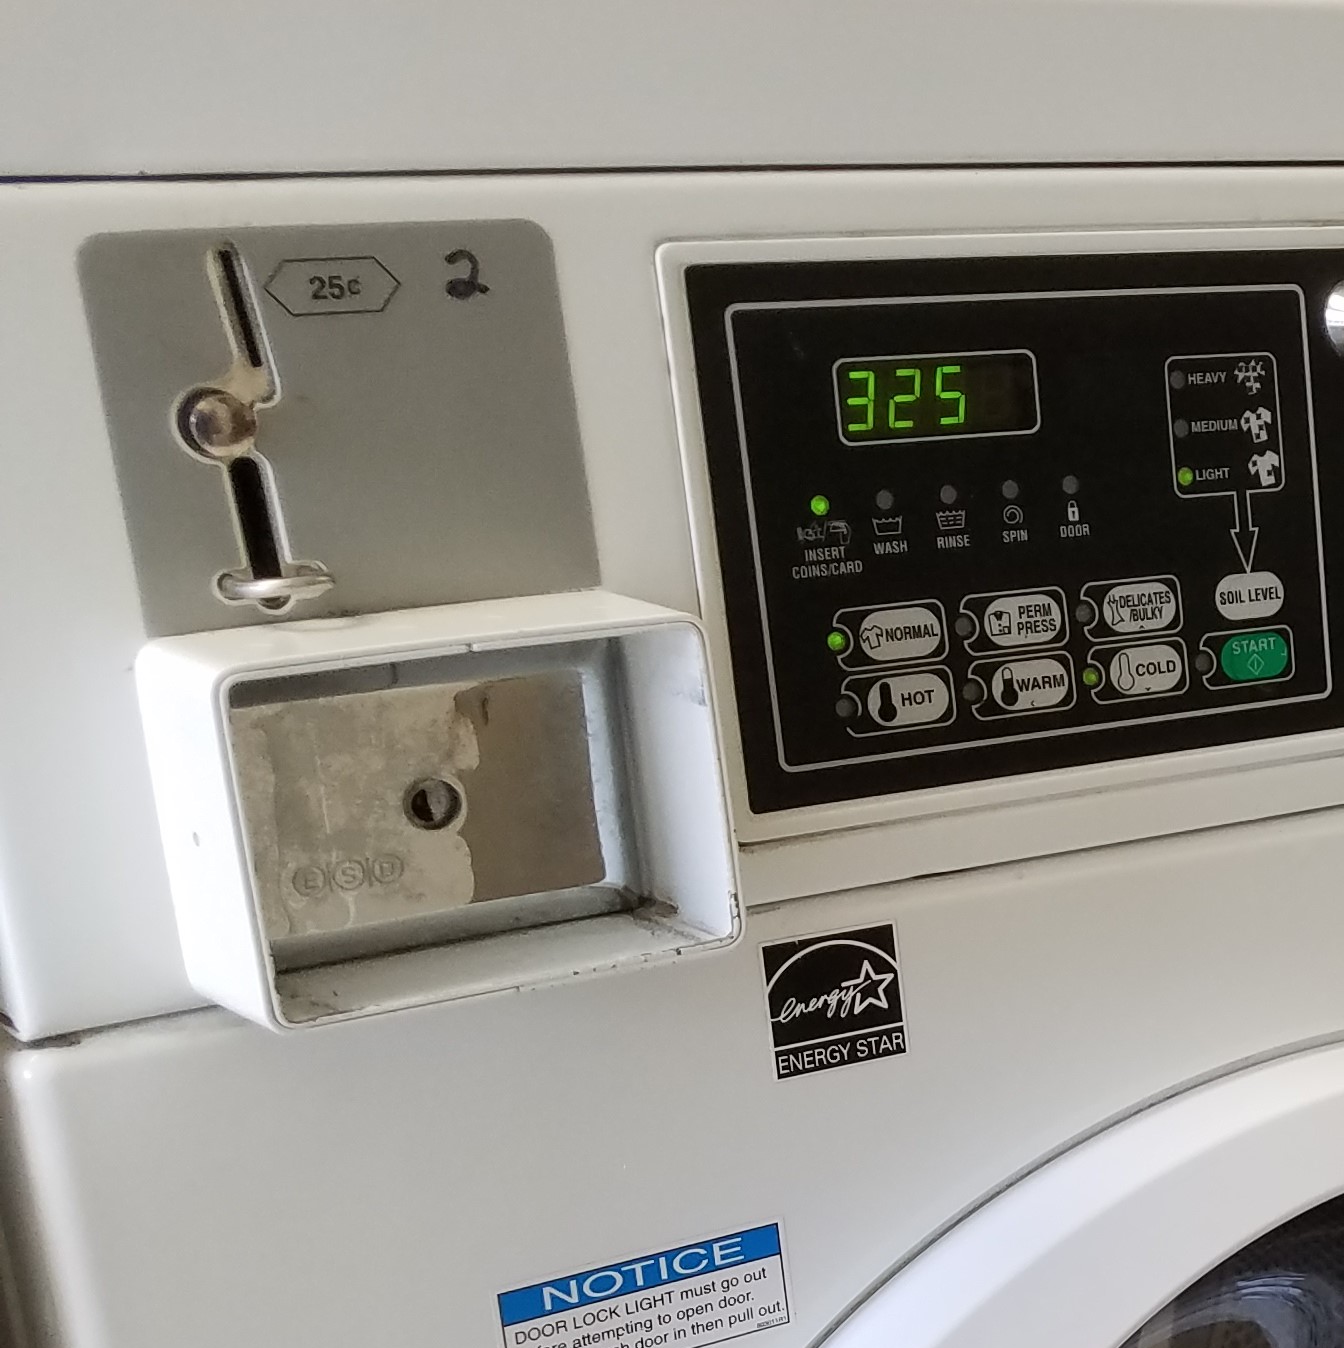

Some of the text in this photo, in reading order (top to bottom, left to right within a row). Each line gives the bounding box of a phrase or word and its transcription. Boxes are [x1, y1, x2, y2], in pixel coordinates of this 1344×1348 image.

[445, 249, 490, 300] 2
[310, 276, 361, 300] 25¢
[1188, 372, 1226, 384] HEAVY
[847, 366, 966, 432] 325
[1191, 419, 1238, 432] MEDIUM
[1196, 468, 1230, 480] LIGHT
[1002, 530, 1028, 542] SPIN
[1060, 524, 1090, 538] DOOR
[874, 540, 908, 554] WASH
[937, 535, 970, 549] RINSE
[804, 546, 846, 562] INSERT
[792, 560, 862, 579] COINS/CARD
[1120, 591, 1171, 608] DELICATES
[1220, 587, 1281, 605] SOIL LEVEL
[1018, 603, 1051, 619] PERM
[1130, 606, 1163, 622] /BULKY
[885, 623, 938, 643] NORMAL
[1017, 619, 1056, 635] PRESS
[1232, 637, 1276, 655] START
[1136, 660, 1176, 676] COLD
[1016, 674, 1065, 693] WARM
[901, 690, 934, 707] HOT
[778, 1032, 904, 1074] ENERGY STAR
[542, 1238, 745, 1310] NOTICE
[514, 1268, 767, 1345] DOOR LOCK LIGHT must go out
[572, 1320, 652, 1348] attempting
[658, 1314, 672, 1325] to
[676, 1304, 714, 1321] open
[720, 1292, 754, 1309] door.
[674, 1328, 686, 1340] in
[691, 1317, 723, 1336] then
[728, 1307, 754, 1328] pull
[758, 1300, 785, 1316] out.
